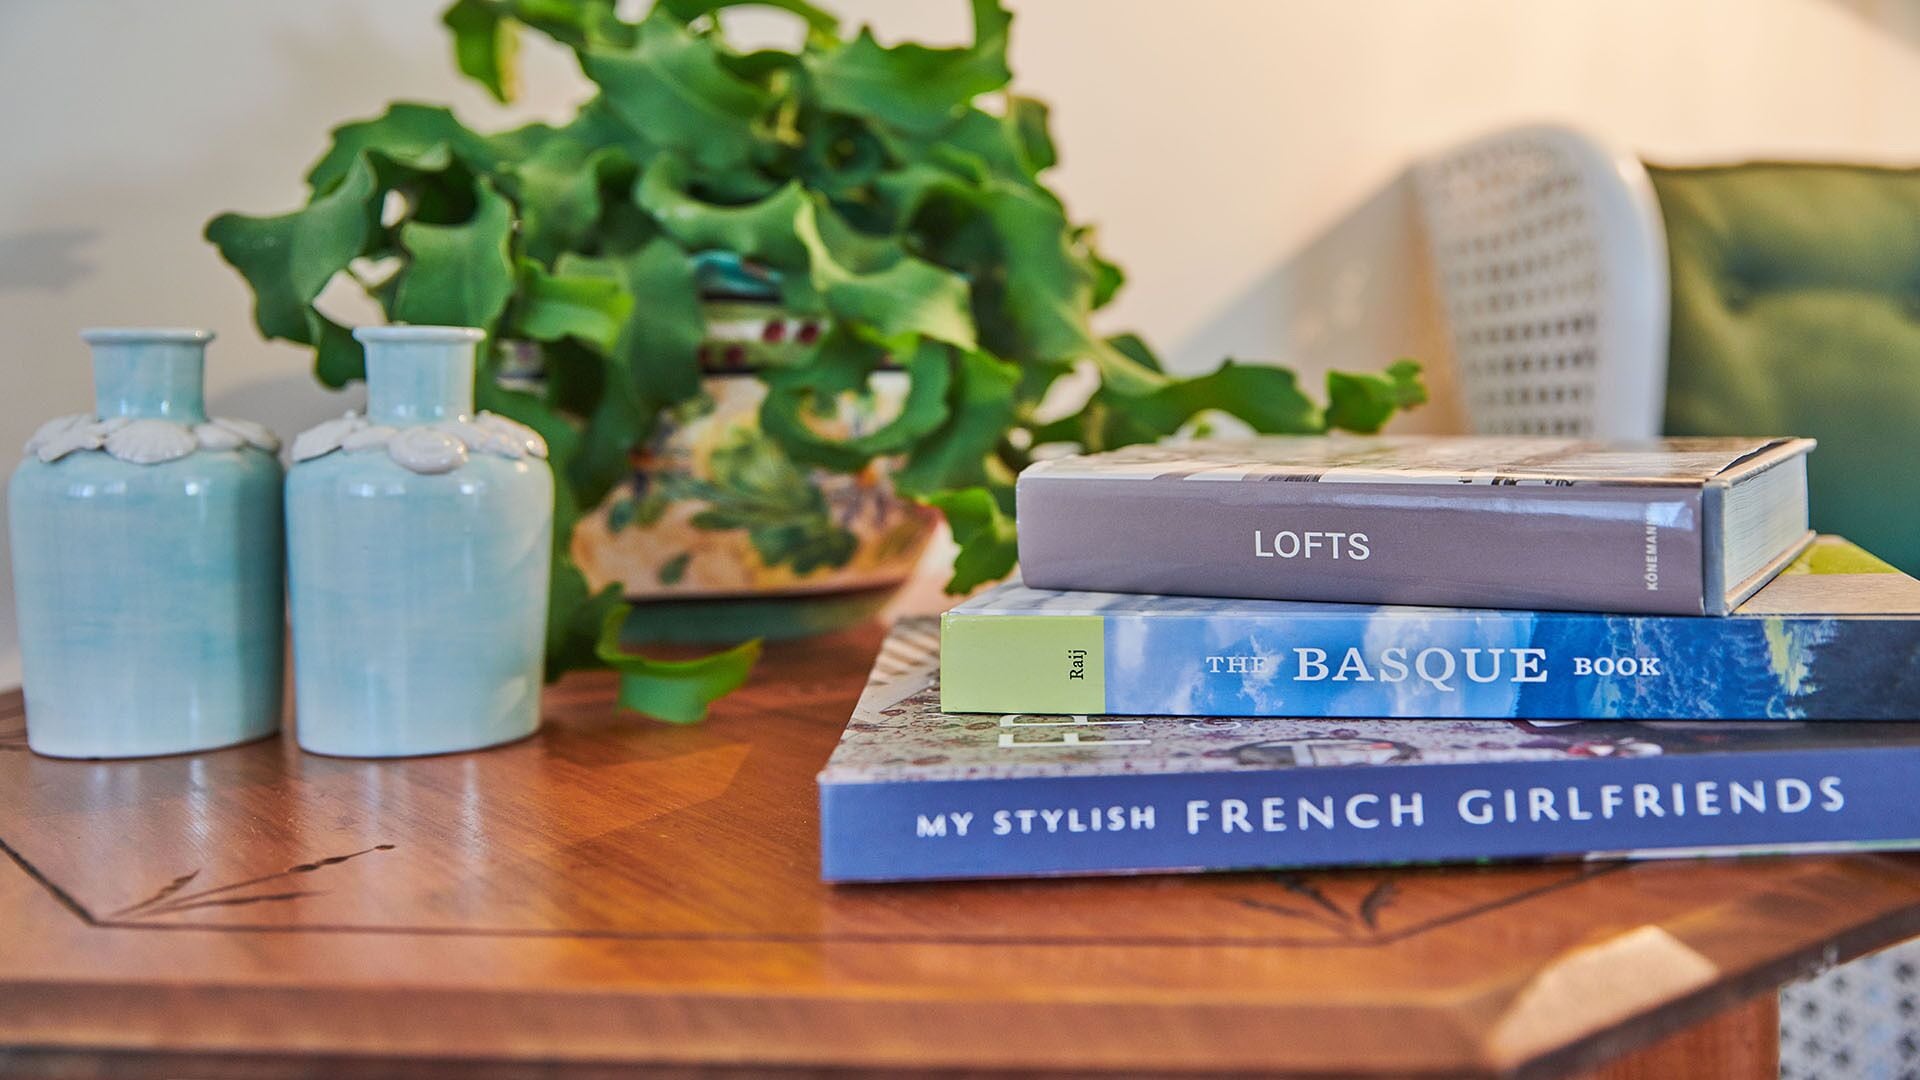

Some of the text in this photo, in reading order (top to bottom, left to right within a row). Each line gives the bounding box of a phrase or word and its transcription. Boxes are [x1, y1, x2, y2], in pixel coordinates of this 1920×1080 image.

[1254, 530, 1370, 561] LOFTS
[1068, 649, 1087, 680] Raij
[1206, 647, 1661, 692] THE BASQUE BOOK
[916, 775, 1845, 838] MY STYLISH FRENCH GIRLFRIENDS
